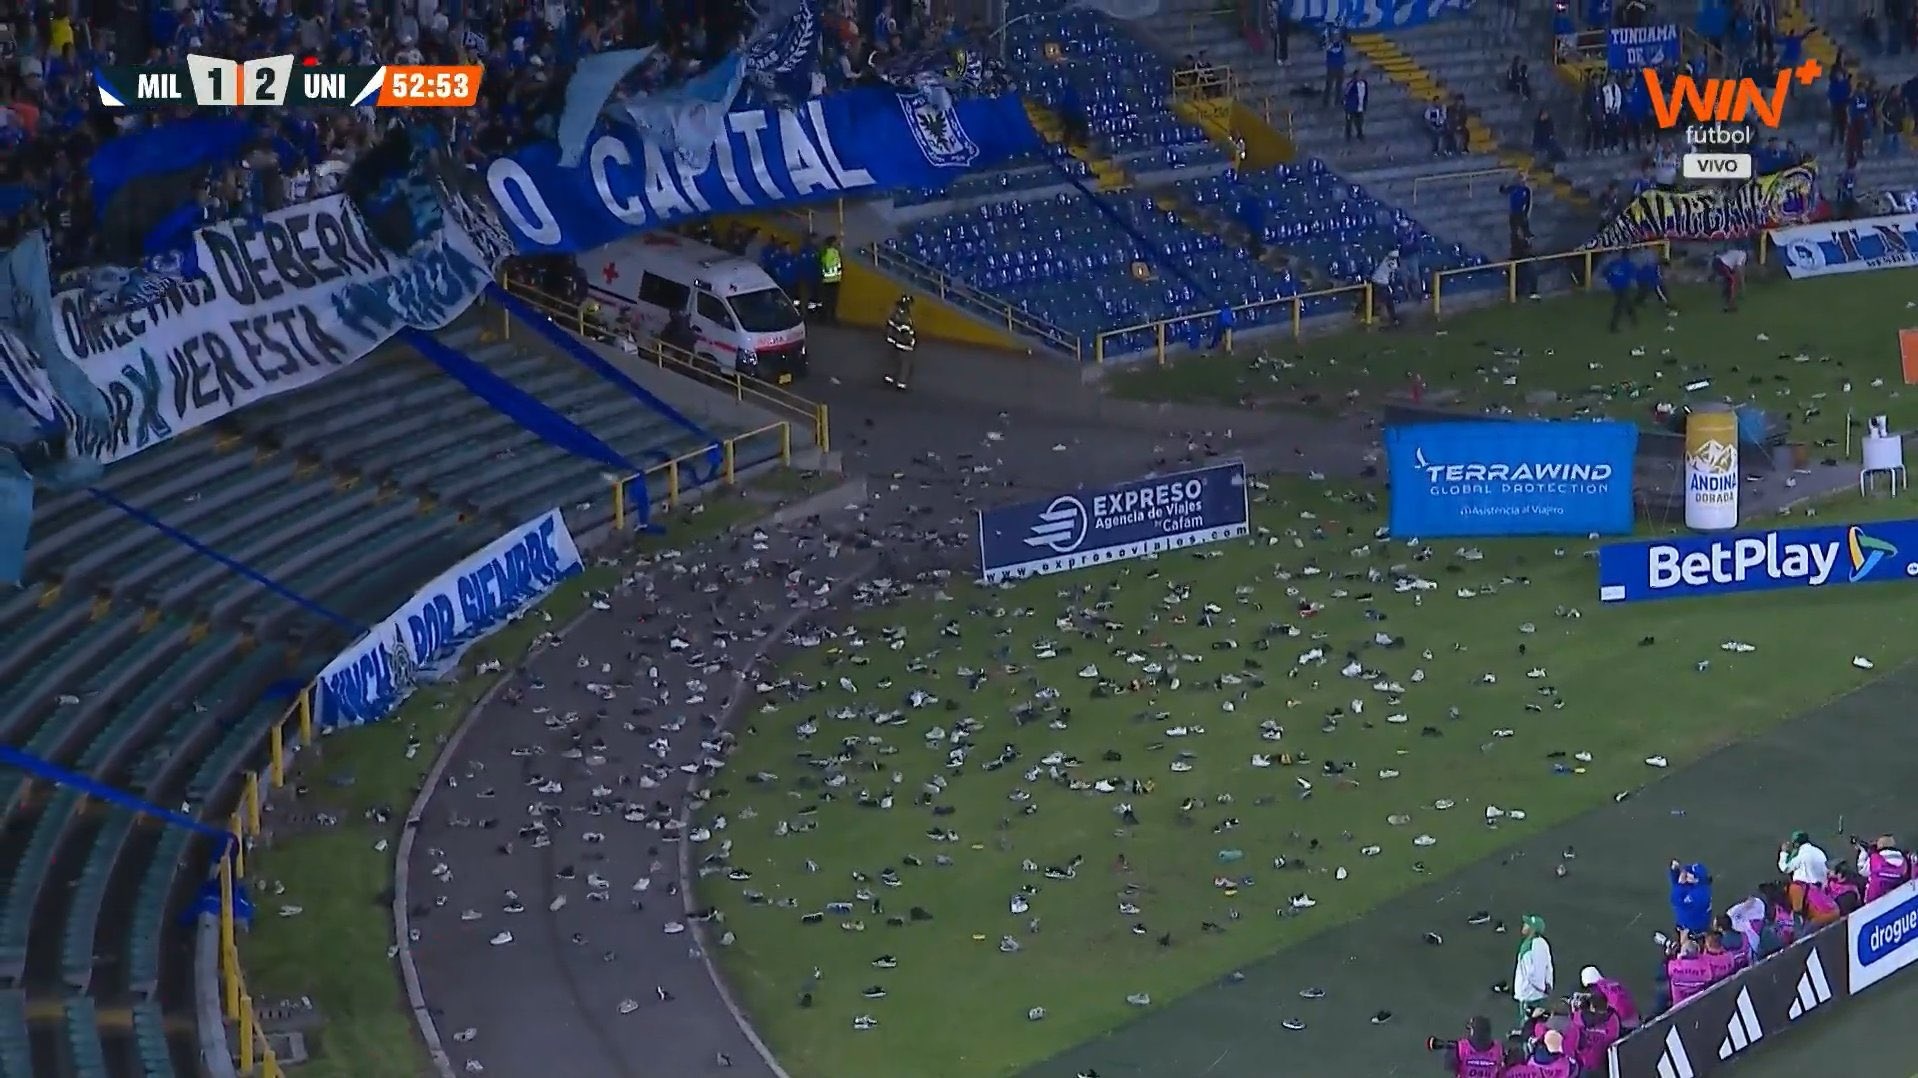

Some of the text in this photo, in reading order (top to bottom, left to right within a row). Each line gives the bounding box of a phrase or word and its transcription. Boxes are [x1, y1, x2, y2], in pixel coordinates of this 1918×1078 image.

[166, 332, 254, 415] VER
[210, 305, 347, 382] ESTA
[1426, 463, 1612, 483] TERRAWIND
[1690, 472, 1737, 491] ANDINA
[1094, 479, 1202, 516] EXPRESO
[1430, 482, 1608, 496] GLOBAL PROTECTION
[1095, 511, 1144, 530] Agencia
[1166, 500, 1202, 517] Viajes
[1163, 515, 1203, 532] Cafam
[1649, 532, 1841, 588] BetPlay
